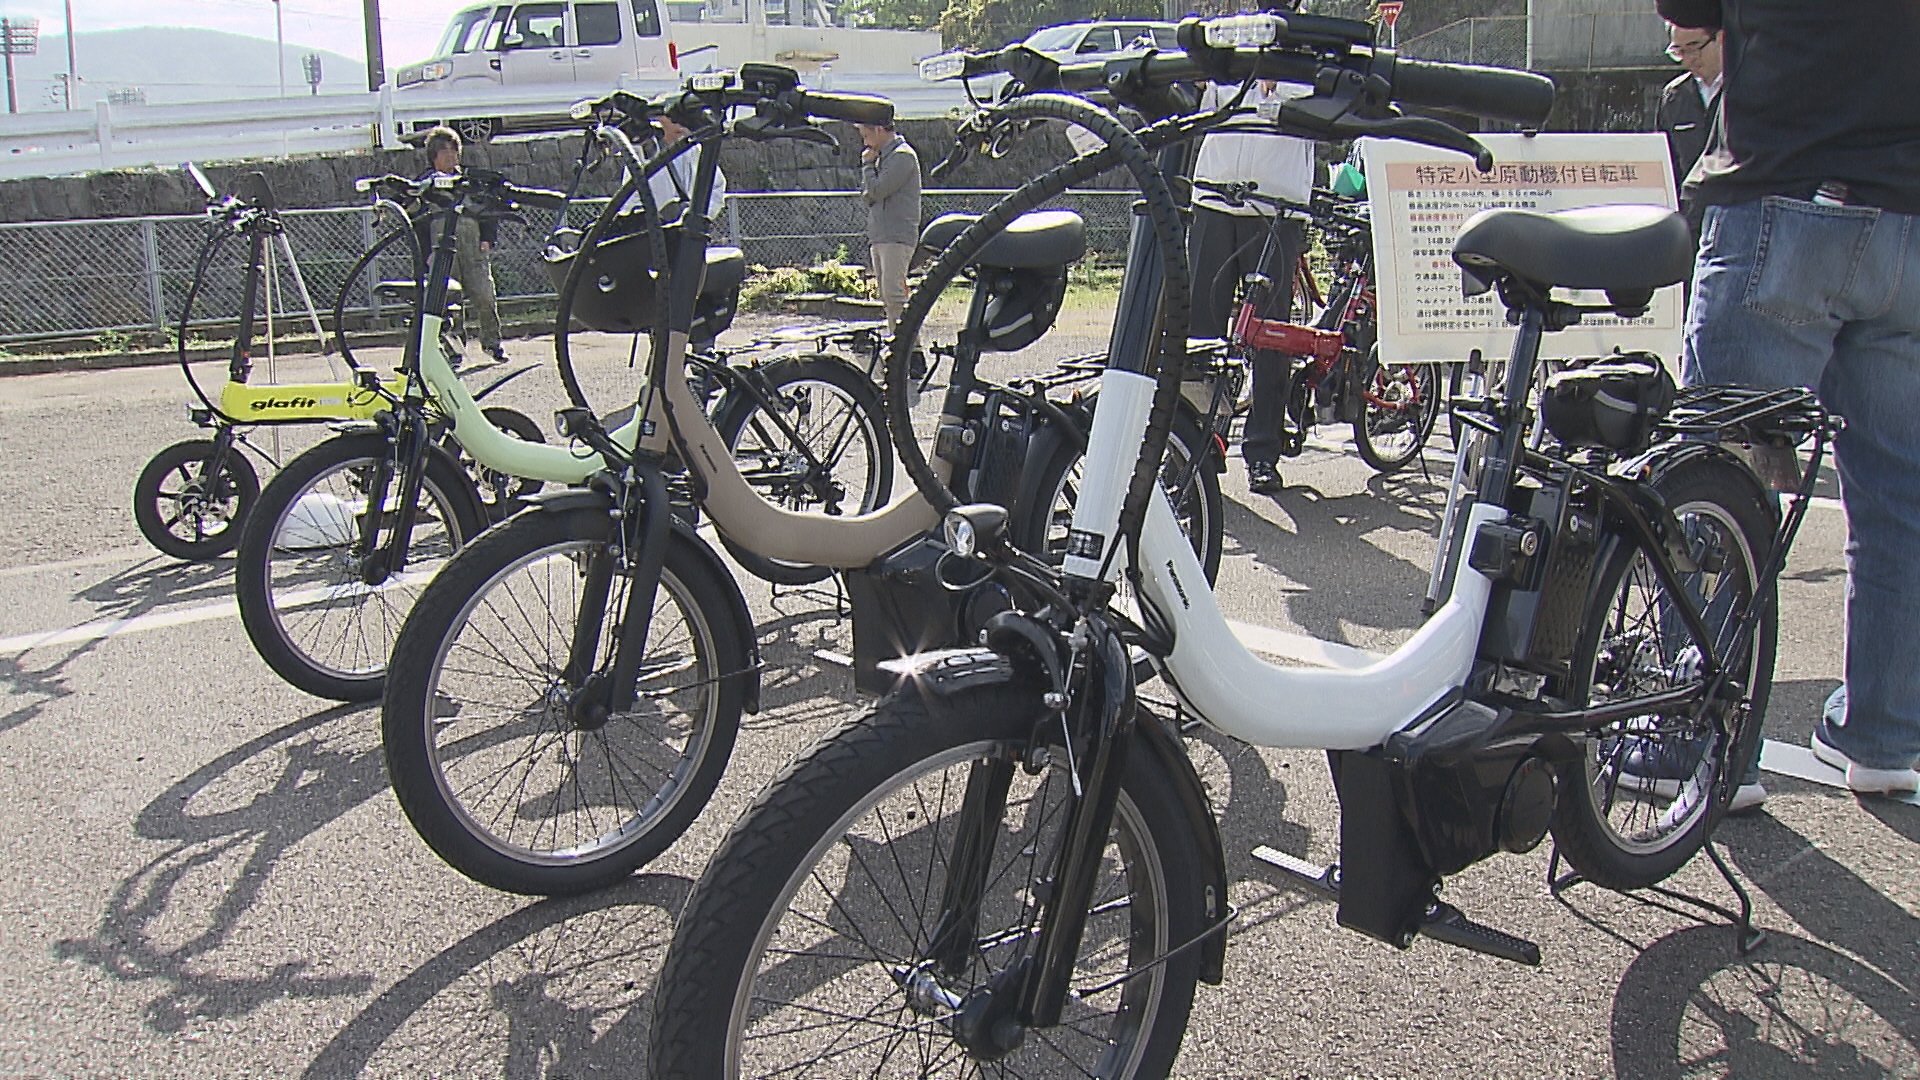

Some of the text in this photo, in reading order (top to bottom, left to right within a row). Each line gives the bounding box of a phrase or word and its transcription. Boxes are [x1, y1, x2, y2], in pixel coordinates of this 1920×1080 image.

[1416, 164, 1639, 184] 特定小型原動機付自転車
[250, 396, 317, 411] glafit
